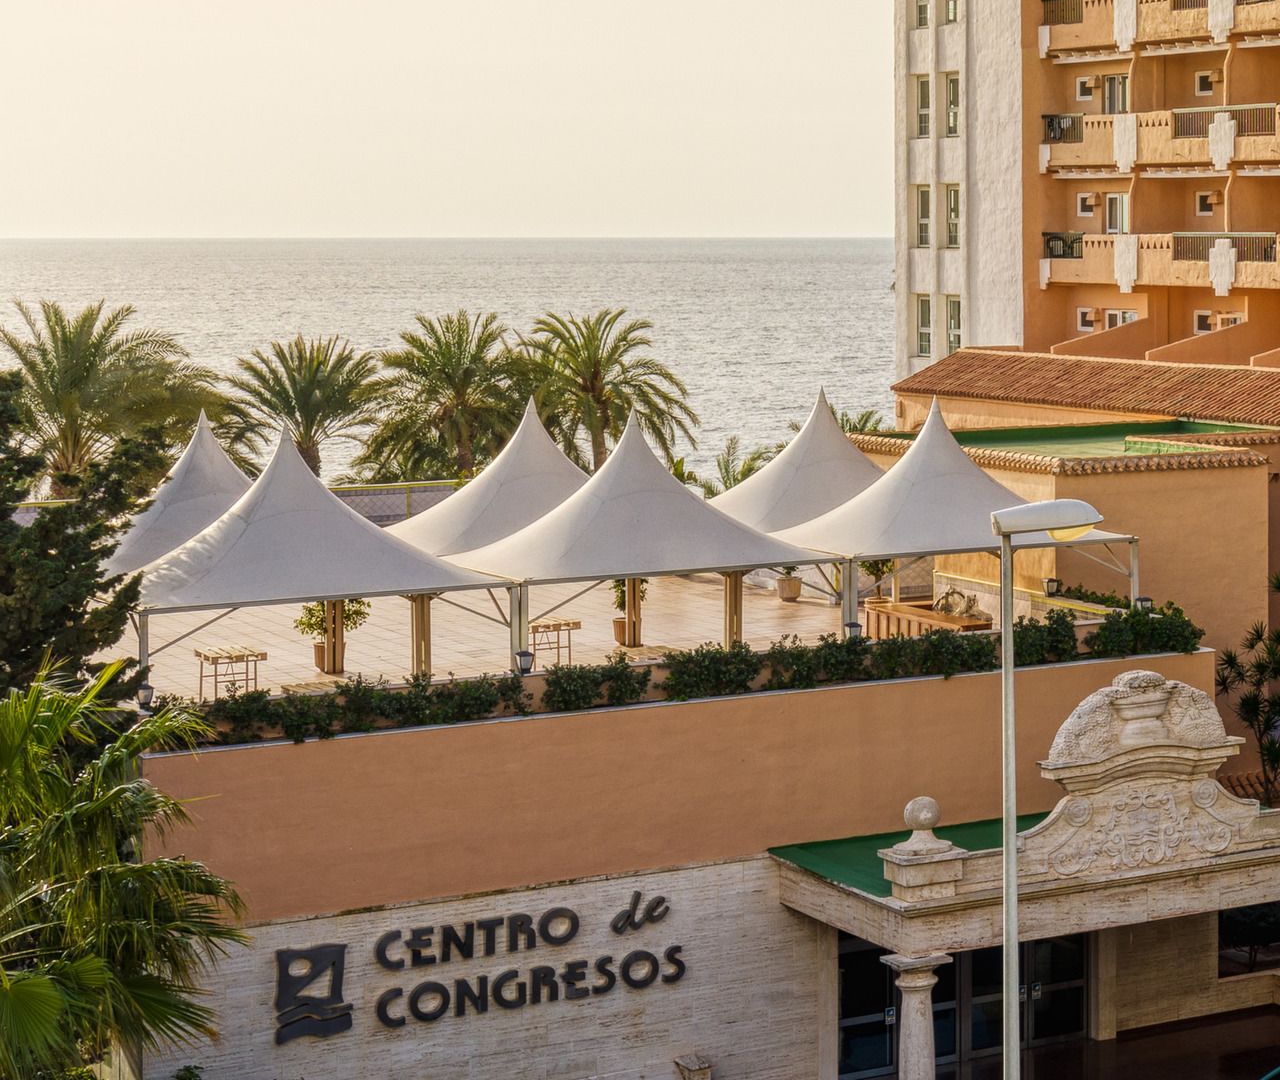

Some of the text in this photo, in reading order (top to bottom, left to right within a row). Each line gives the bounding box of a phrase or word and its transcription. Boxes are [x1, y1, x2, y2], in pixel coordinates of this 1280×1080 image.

[375, 890, 670, 971] CENTRO de
[376, 945, 686, 1028] CONGRESOS
